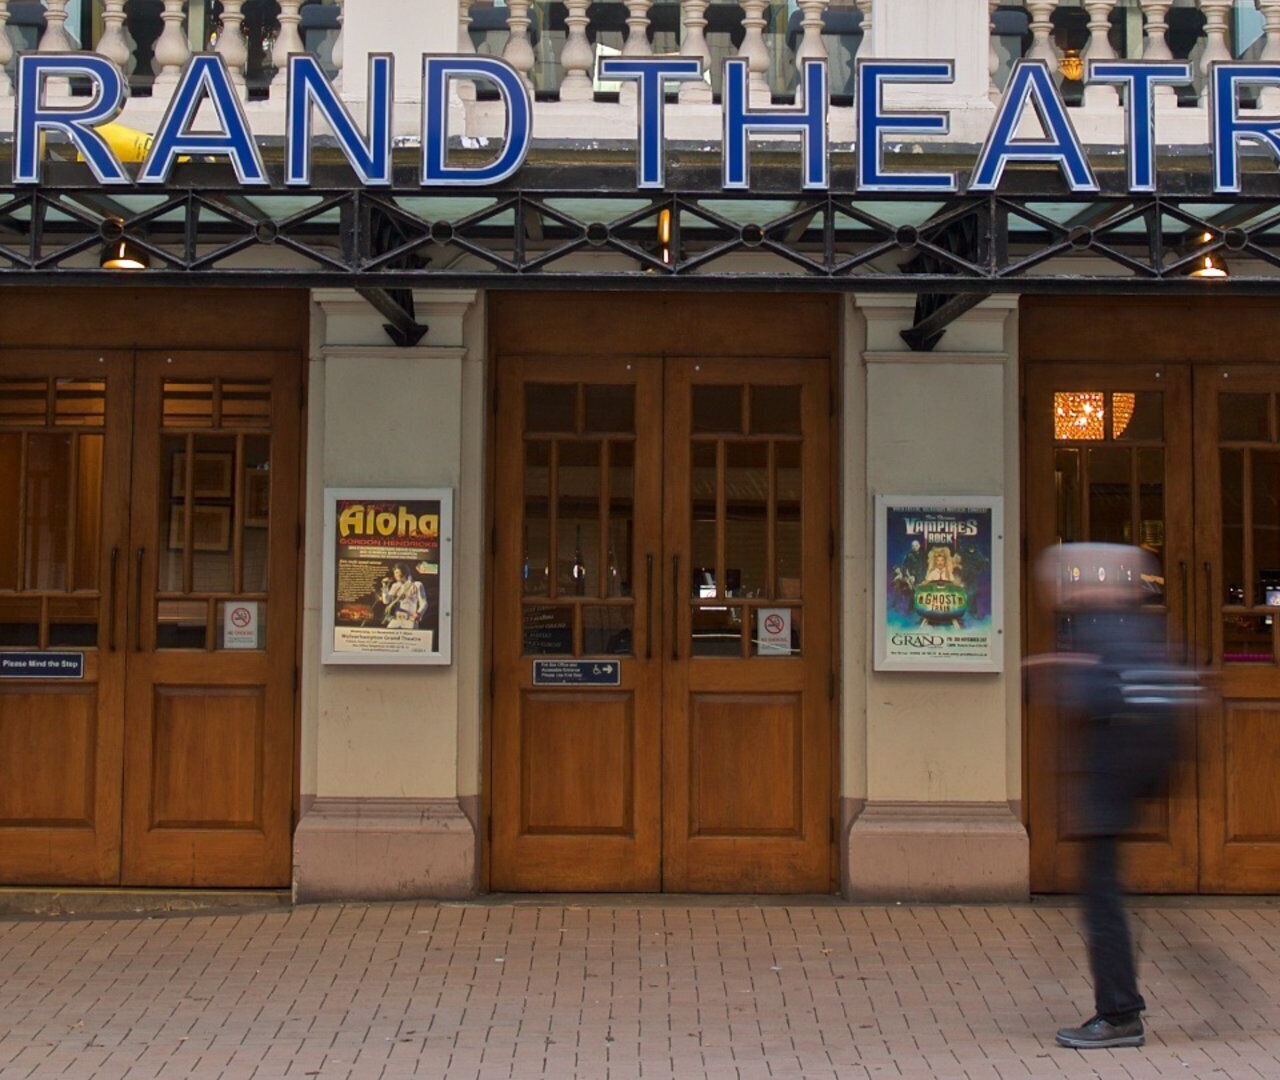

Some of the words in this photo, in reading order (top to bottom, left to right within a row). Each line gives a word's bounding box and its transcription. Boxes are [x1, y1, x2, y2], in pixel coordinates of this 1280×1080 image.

[339, 504, 439, 537] Aloha
[905, 517, 978, 539] VAMPIRES
[340, 538, 381, 546] GORDON
[383, 539, 438, 548] HENDRICKS
[928, 532, 954, 544] ROCK
[925, 593, 957, 605] GHOST
[891, 635, 945, 648] GRAND
[2, 659, 28, 668] Please
[28, 660, 47, 668] Mind
[47, 660, 60, 668] the
[61, 660, 78, 669] Step
